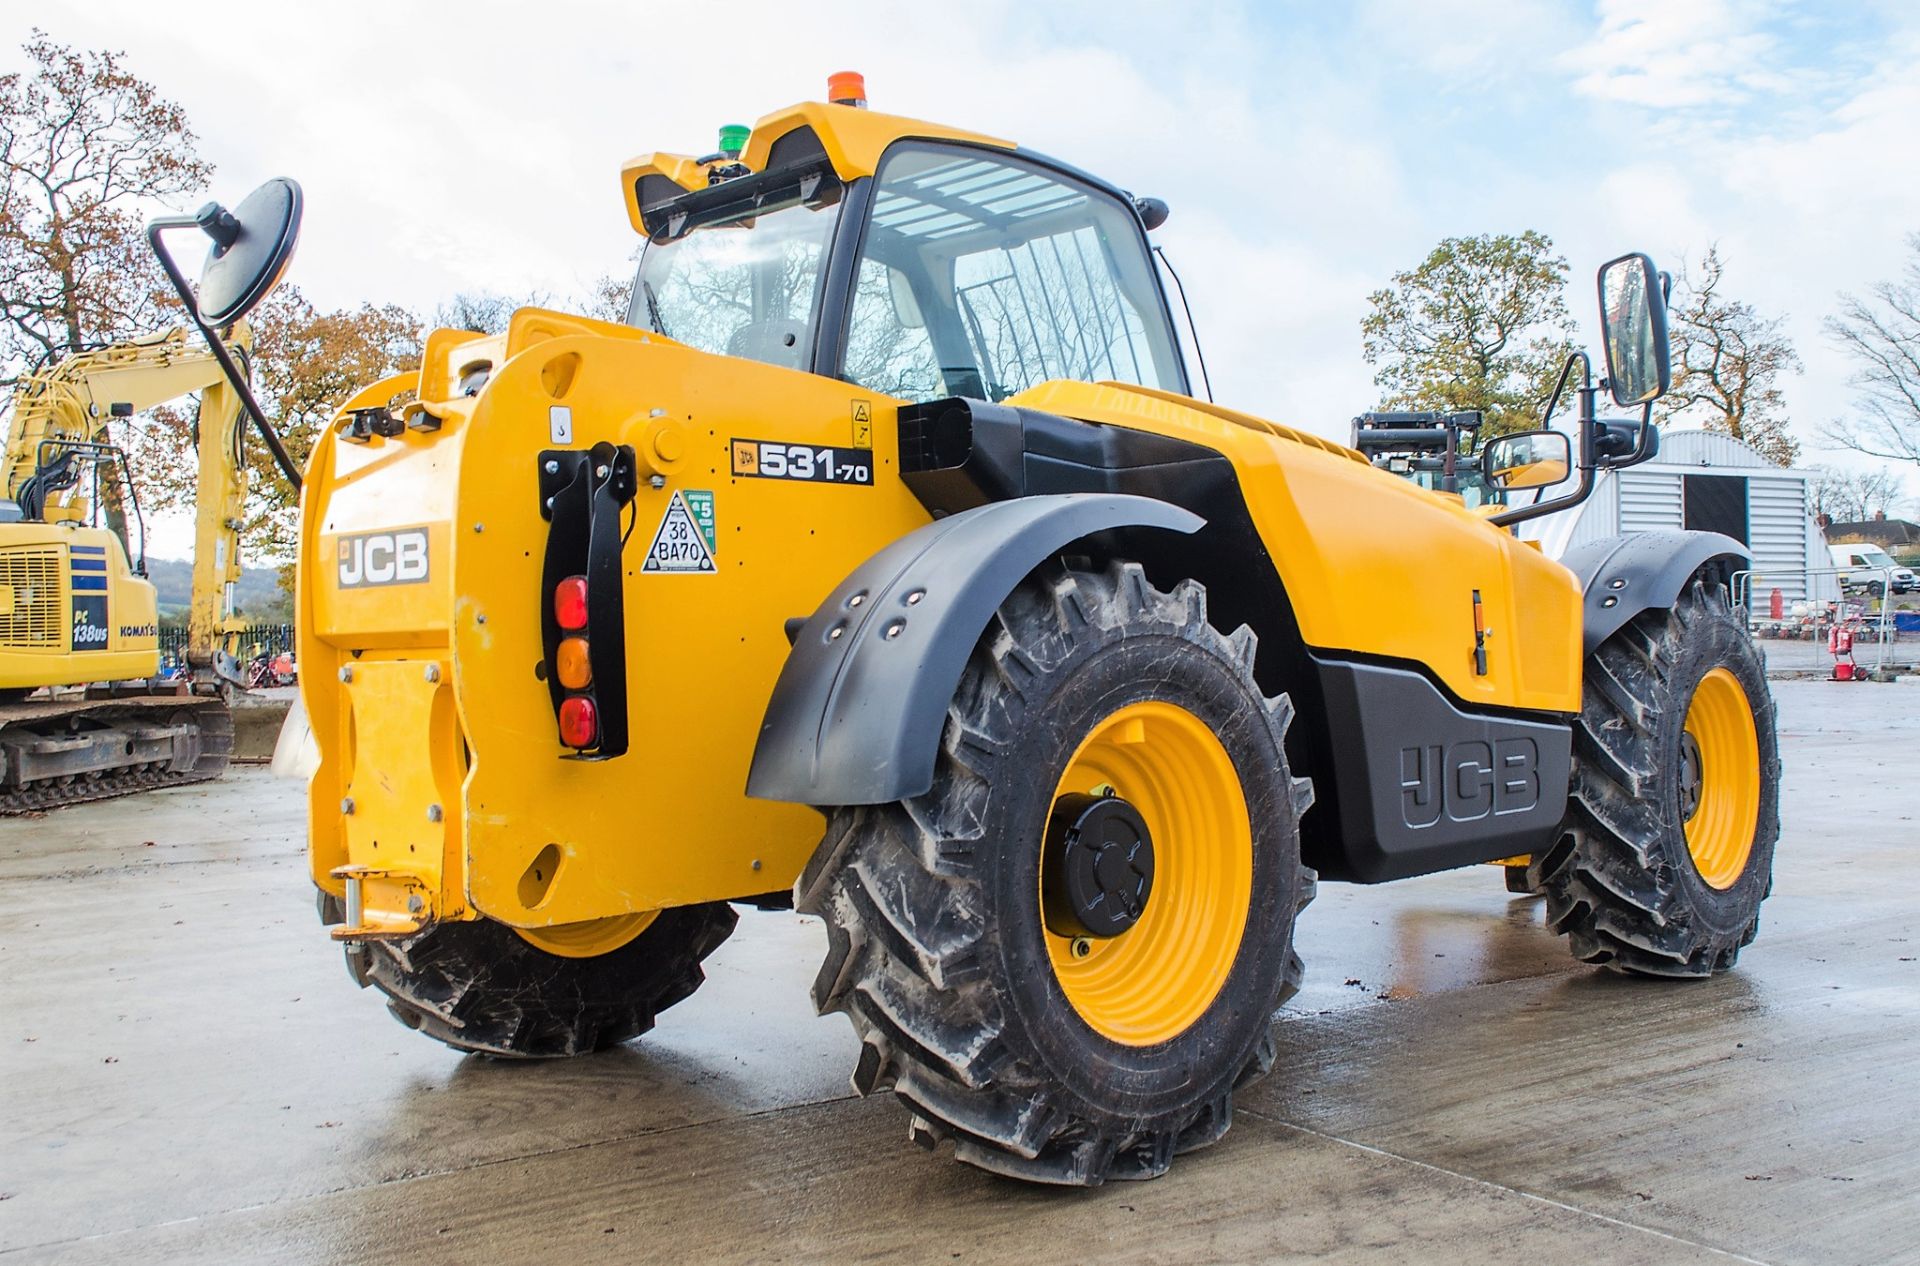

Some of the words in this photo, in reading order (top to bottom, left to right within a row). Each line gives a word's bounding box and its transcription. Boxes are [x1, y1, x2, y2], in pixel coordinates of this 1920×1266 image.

[760, 443, 869, 482] 531-70
[701, 501, 712, 518] 5
[669, 521, 688, 540] 38
[339, 532, 428, 585] JCB
[658, 542, 699, 561] BA70
[74, 609, 89, 624] PC
[73, 624, 108, 642] 138US
[1401, 737, 1540, 830] JCB
